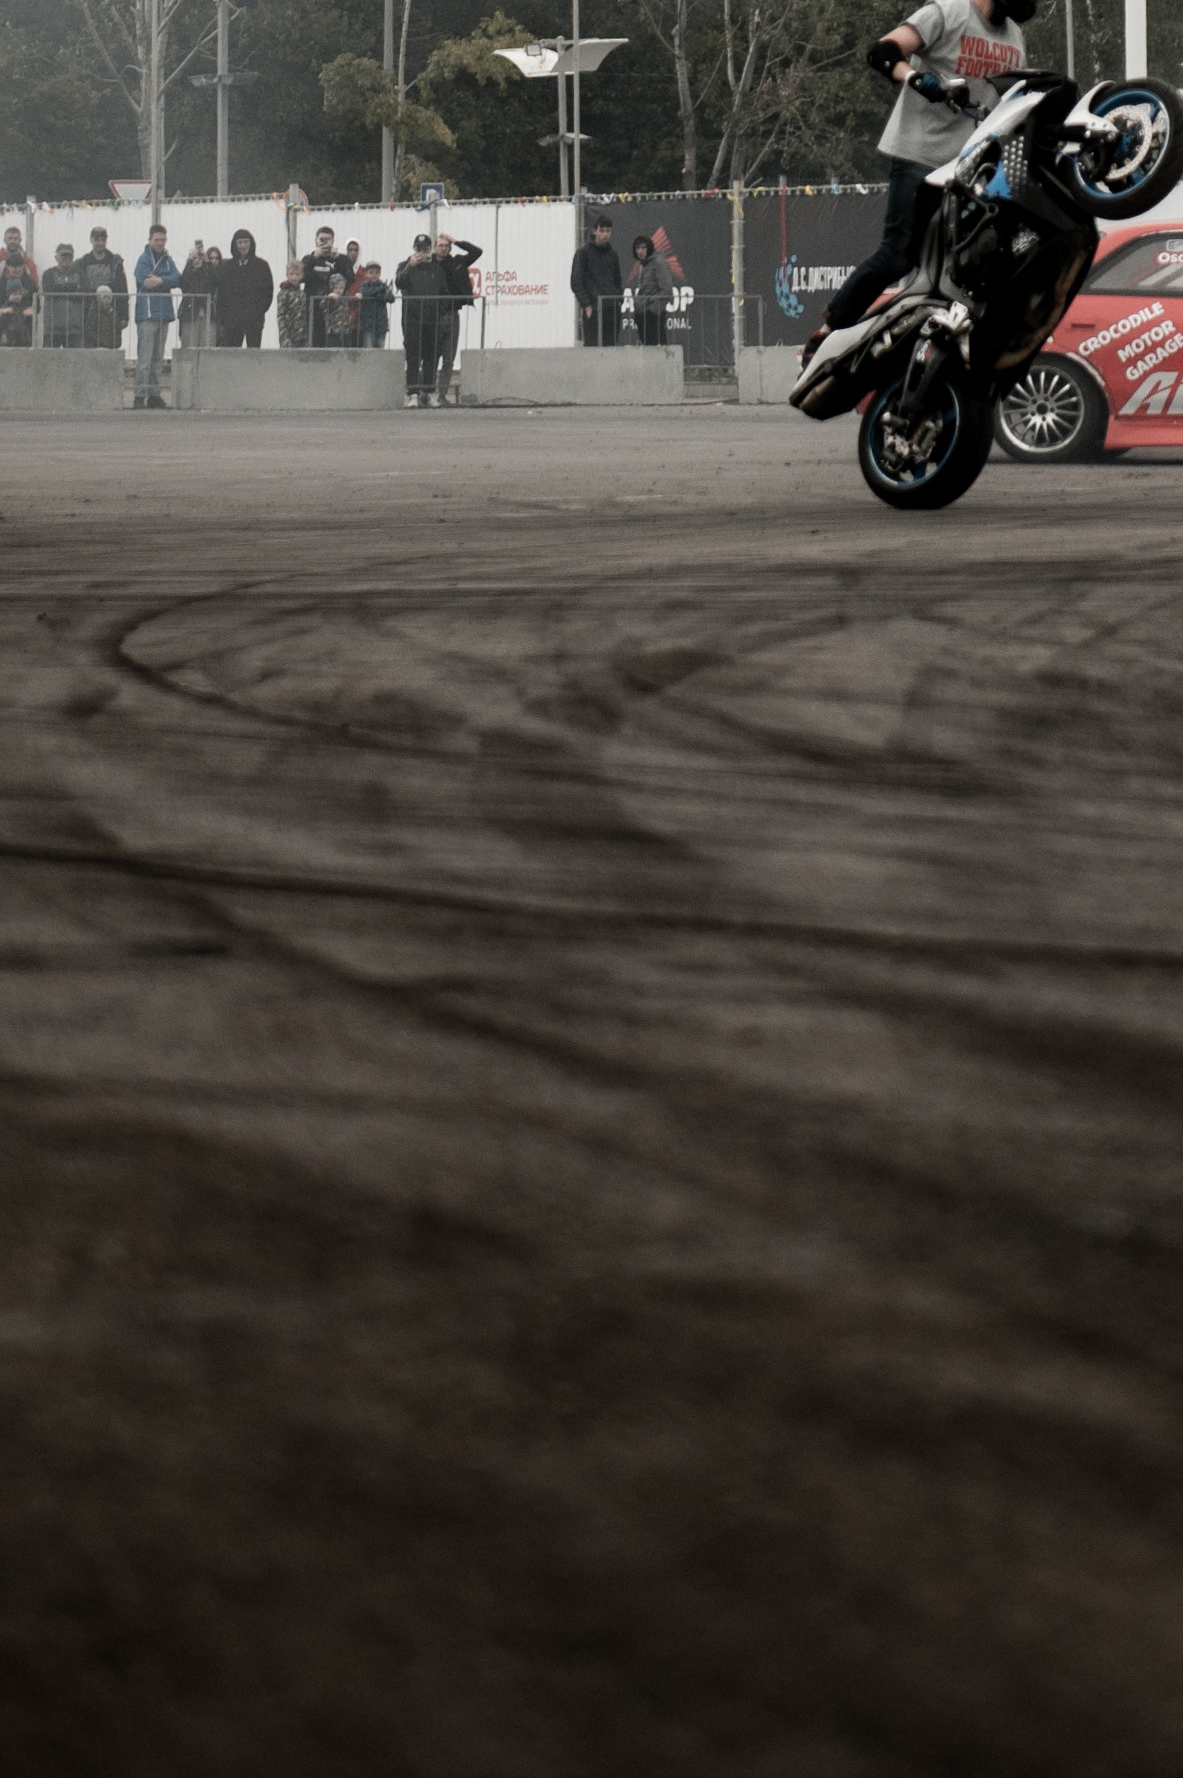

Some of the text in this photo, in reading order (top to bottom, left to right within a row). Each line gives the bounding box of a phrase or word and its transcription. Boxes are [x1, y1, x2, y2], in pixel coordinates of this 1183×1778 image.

[960, 35, 1022, 69] WOLCOTT
[485, 270, 518, 282] АЛЬФА
[485, 284, 549, 296] СТРАХОВАНИЕ
[1078, 301, 1165, 357] CROCODILE
[1116, 319, 1176, 363] MOTOR
